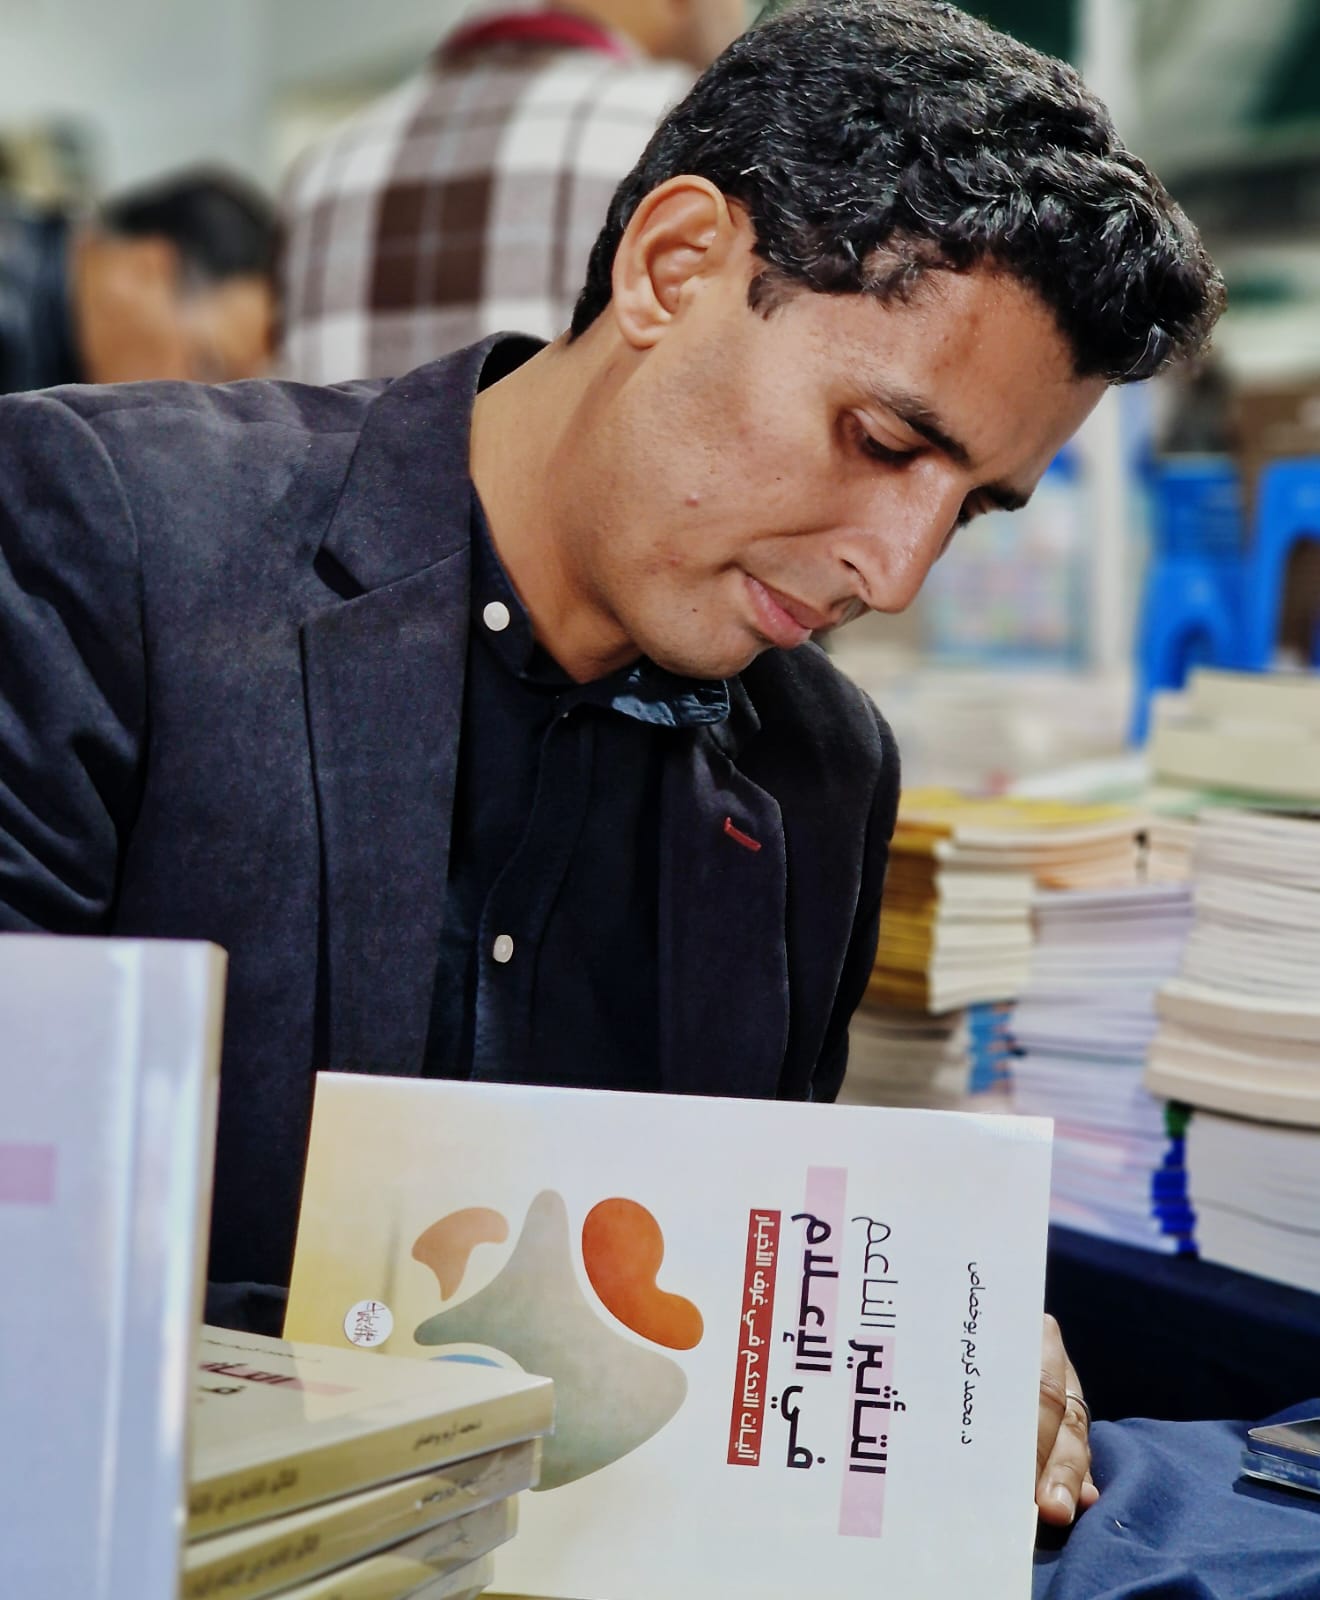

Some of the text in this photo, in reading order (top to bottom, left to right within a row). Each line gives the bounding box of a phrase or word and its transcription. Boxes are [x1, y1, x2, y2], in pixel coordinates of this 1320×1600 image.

[735, 1214, 775, 1461] آليات التحكم في غرف الأخبار
[770, 1213, 839, 1470] في الإعلام
[846, 1216, 907, 1475] التأثير الناعم
[960, 1339, 981, 1377] كريم
[963, 1262, 986, 1335] بوخصاص
[962, 1380, 976, 1426] محمد
